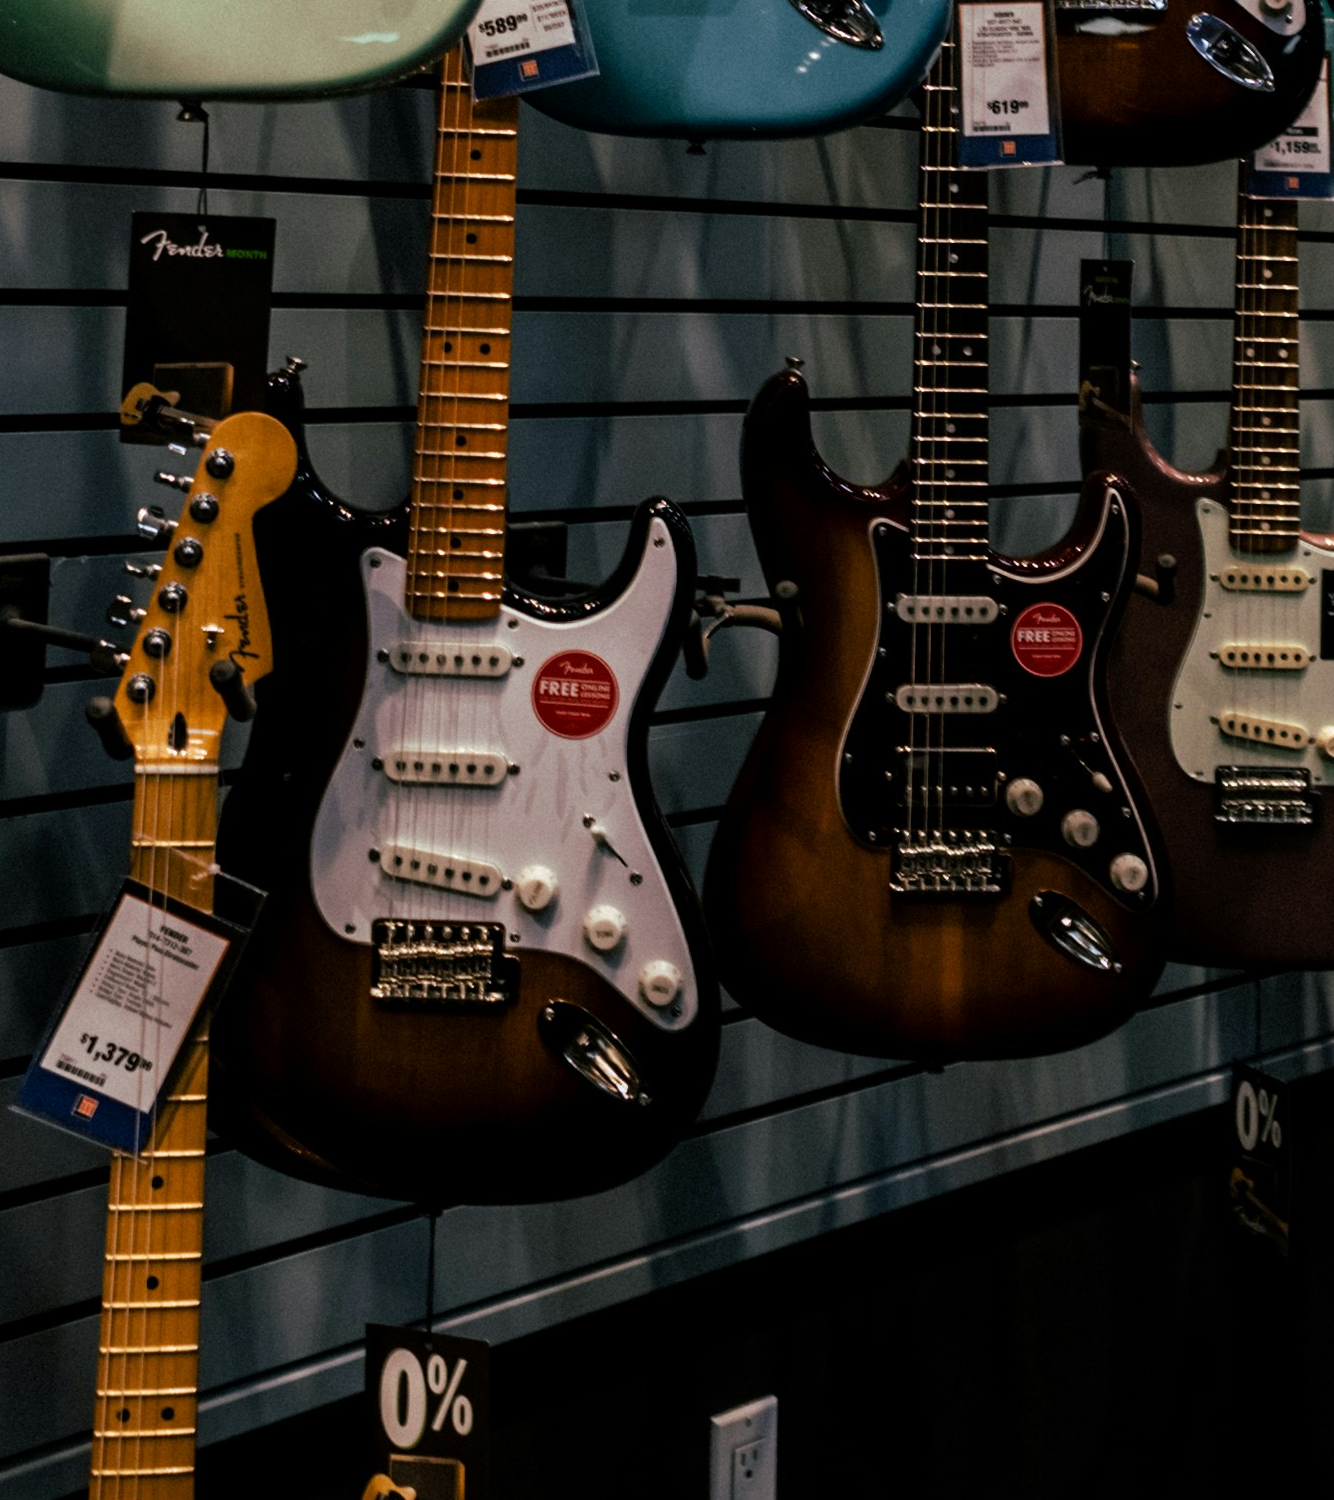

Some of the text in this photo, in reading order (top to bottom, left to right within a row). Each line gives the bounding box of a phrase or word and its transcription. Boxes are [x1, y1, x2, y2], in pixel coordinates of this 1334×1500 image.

[140, 229, 224, 261] Fender
[1032, 612, 1061, 625] Fender
[224, 593, 260, 673] Fender
[1017, 630, 1051, 643] FREE
[559, 660, 594, 675] Fender
[539, 680, 611, 697] FREE ONLINE
[159, 925, 190, 944] FENDER
[1236, 1080, 1282, 1152] 0%
[380, 1347, 474, 1450] 0%
